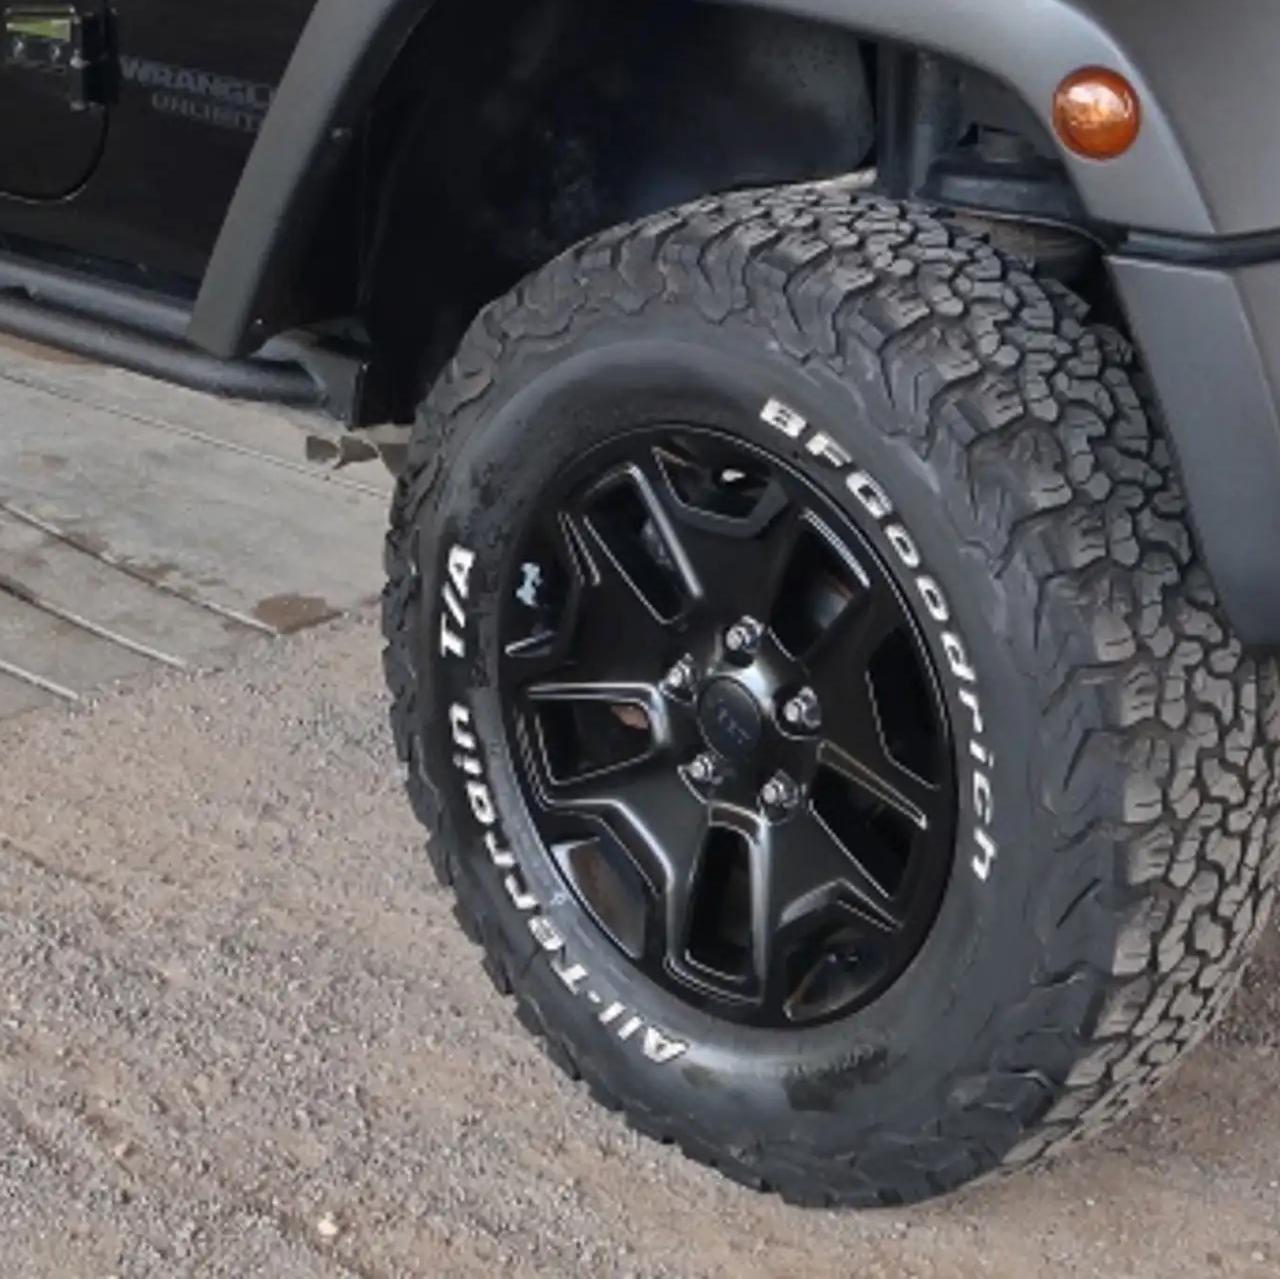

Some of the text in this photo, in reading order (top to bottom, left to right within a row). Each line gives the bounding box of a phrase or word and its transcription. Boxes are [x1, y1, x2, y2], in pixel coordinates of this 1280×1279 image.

[119, 55, 276, 110] WRANGL
[439, 543, 688, 1063] All-Terrain T/A
[759, 396, 998, 882] BFGoodrich
